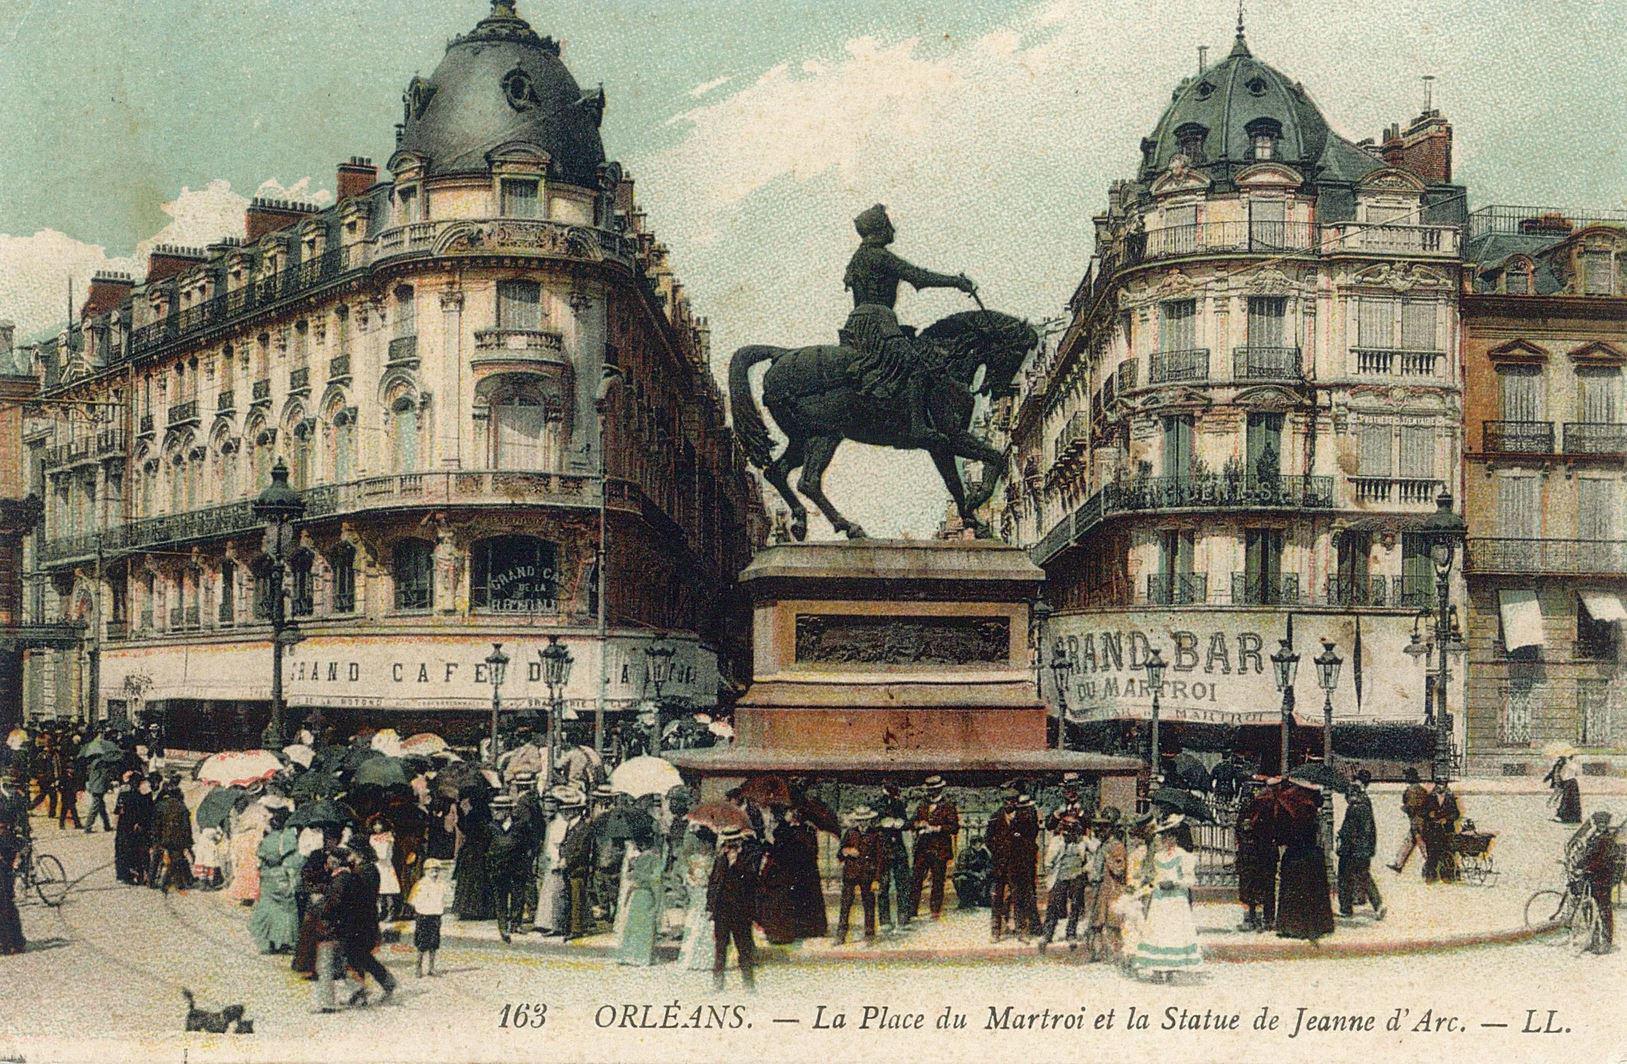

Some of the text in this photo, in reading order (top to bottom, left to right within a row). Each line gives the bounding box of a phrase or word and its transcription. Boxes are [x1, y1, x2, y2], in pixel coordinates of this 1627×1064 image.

[490, 565, 535, 591] GRAND
[535, 583, 546, 592] LA
[1173, 630, 1265, 675] BAR
[1077, 677, 1218, 702] DU MARTROI
